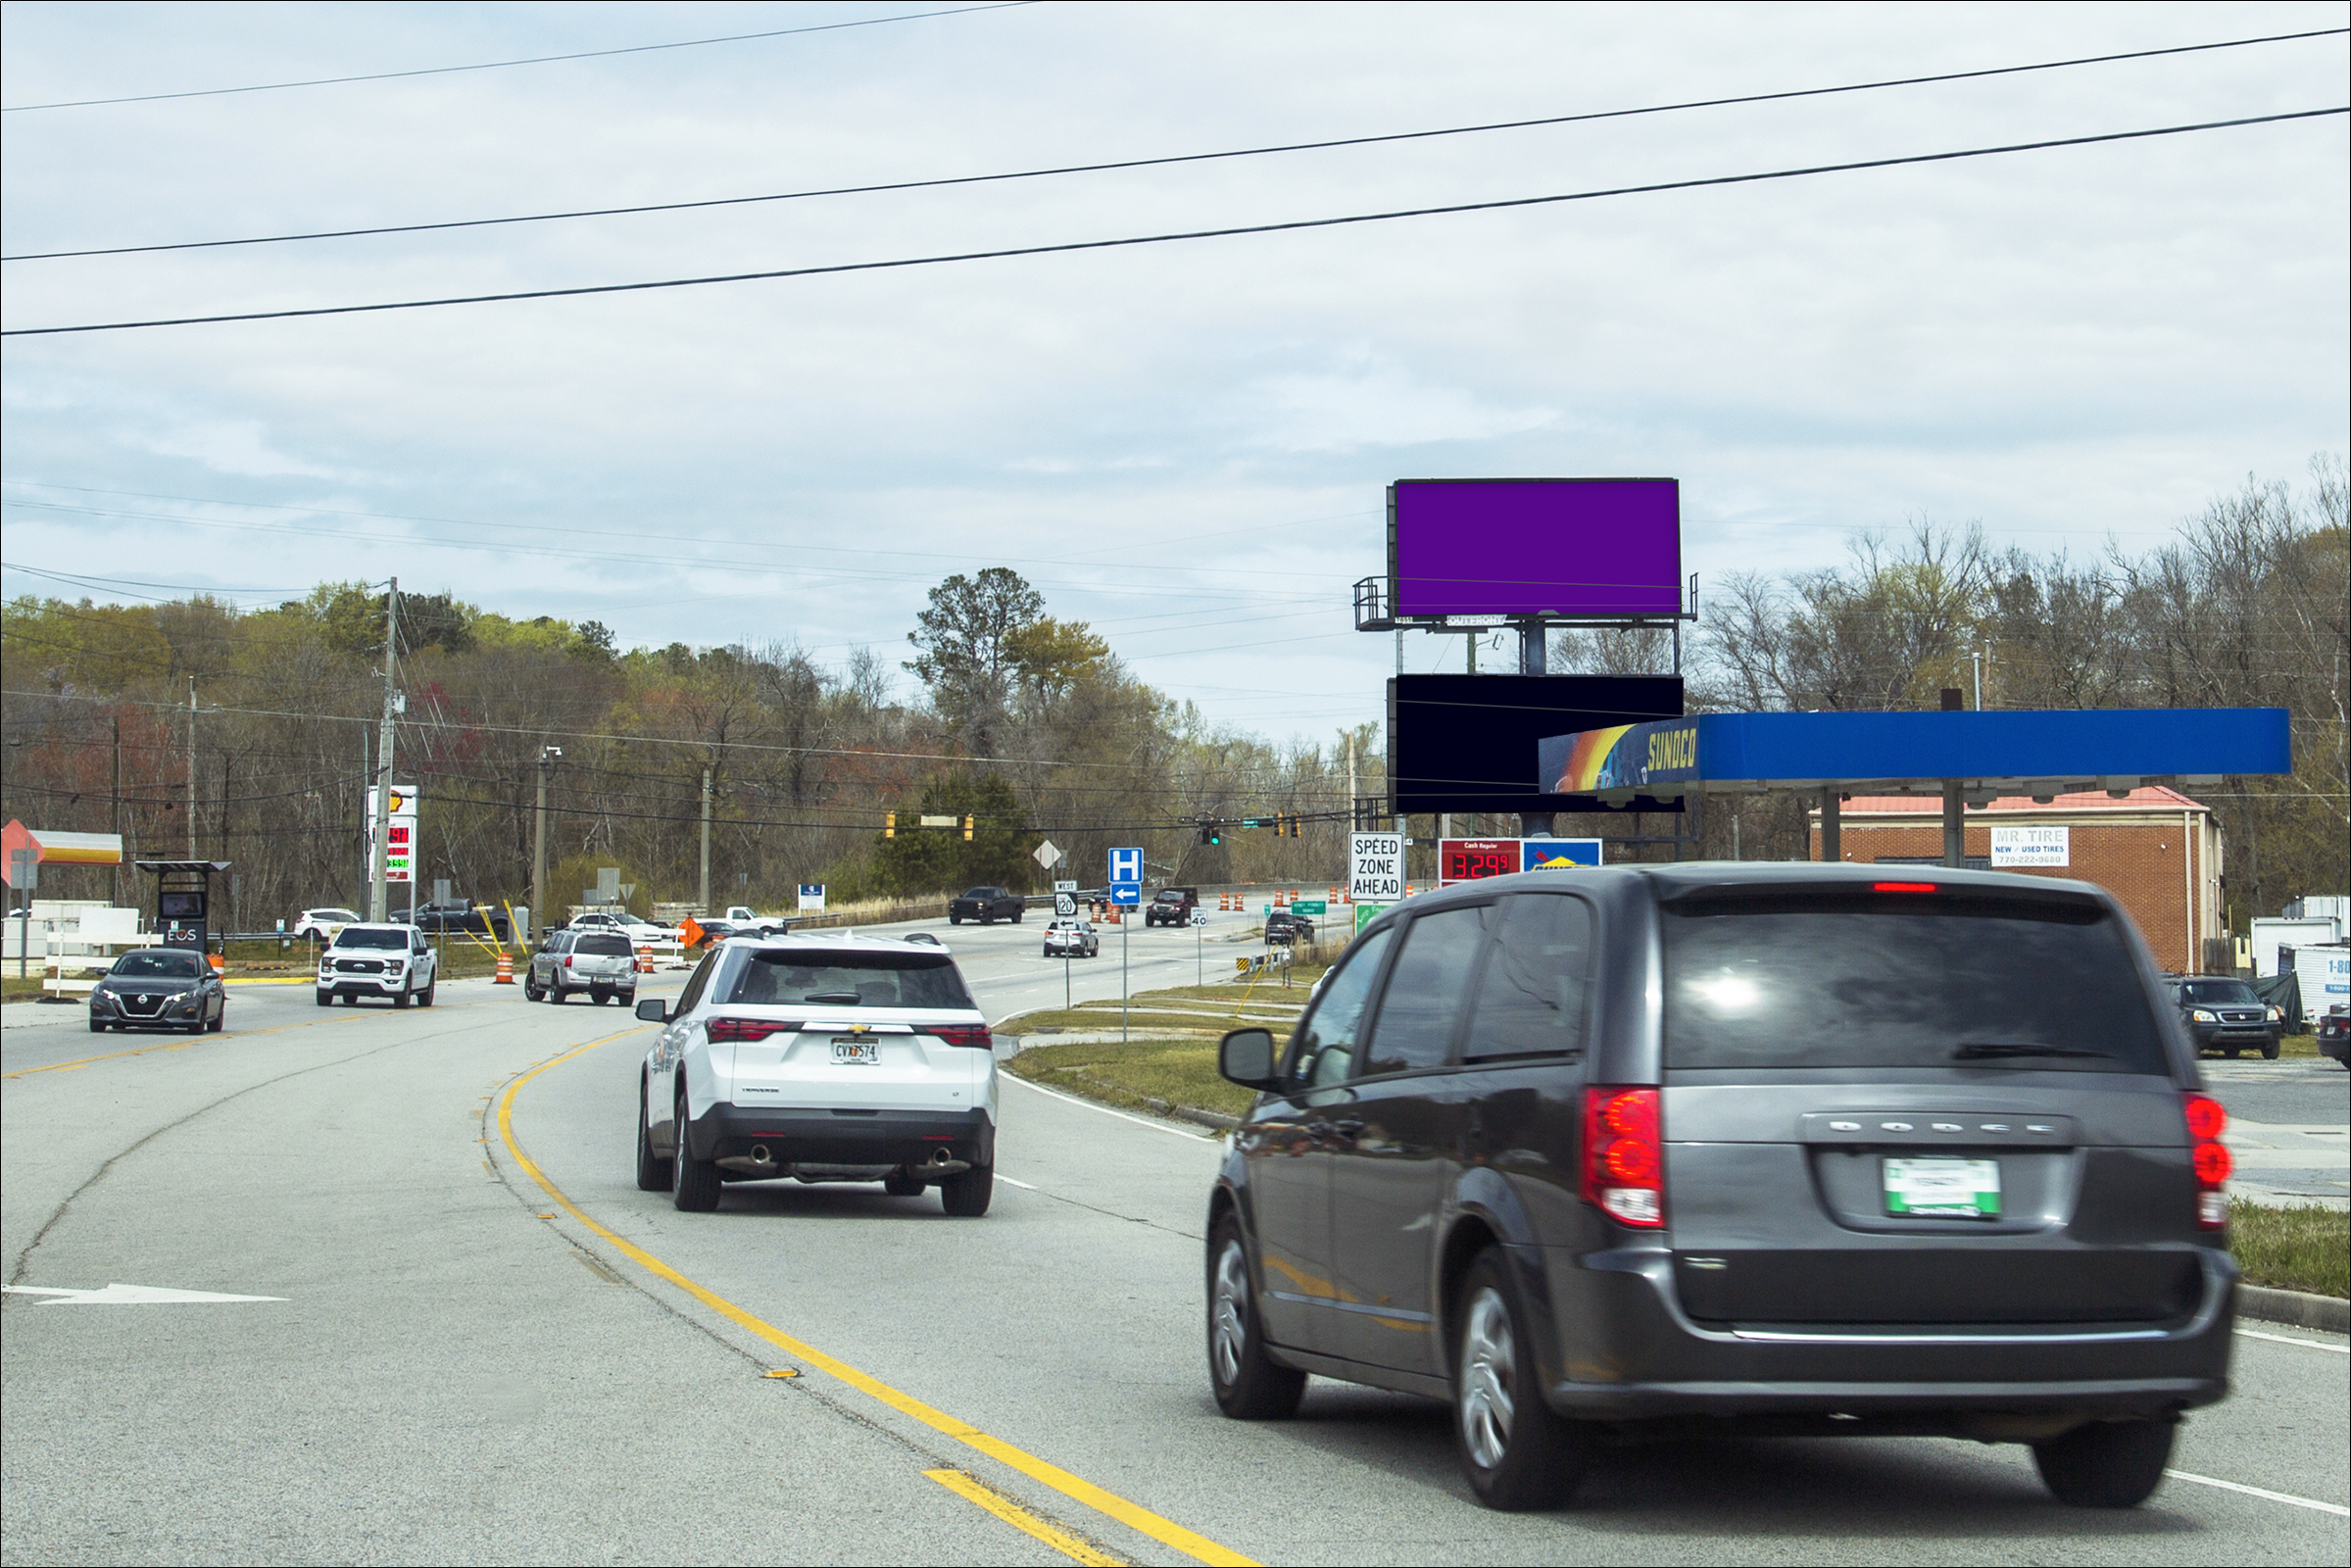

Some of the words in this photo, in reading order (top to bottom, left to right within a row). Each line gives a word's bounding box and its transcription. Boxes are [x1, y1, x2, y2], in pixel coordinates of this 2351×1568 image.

[1447, 616, 1504, 625] OUTFRONT
[1647, 728, 1696, 771] SUNOCO
[1997, 830, 2023, 843] MR.
[2028, 830, 2063, 843] TIRE
[1355, 839, 1397, 855] SPEED
[1113, 850, 1139, 880] H
[1358, 859, 1395, 874] ZONE
[1353, 878, 1398, 895] AHEAD
[1058, 900, 1072, 912] 120
[168, 929, 196, 941] EOS
